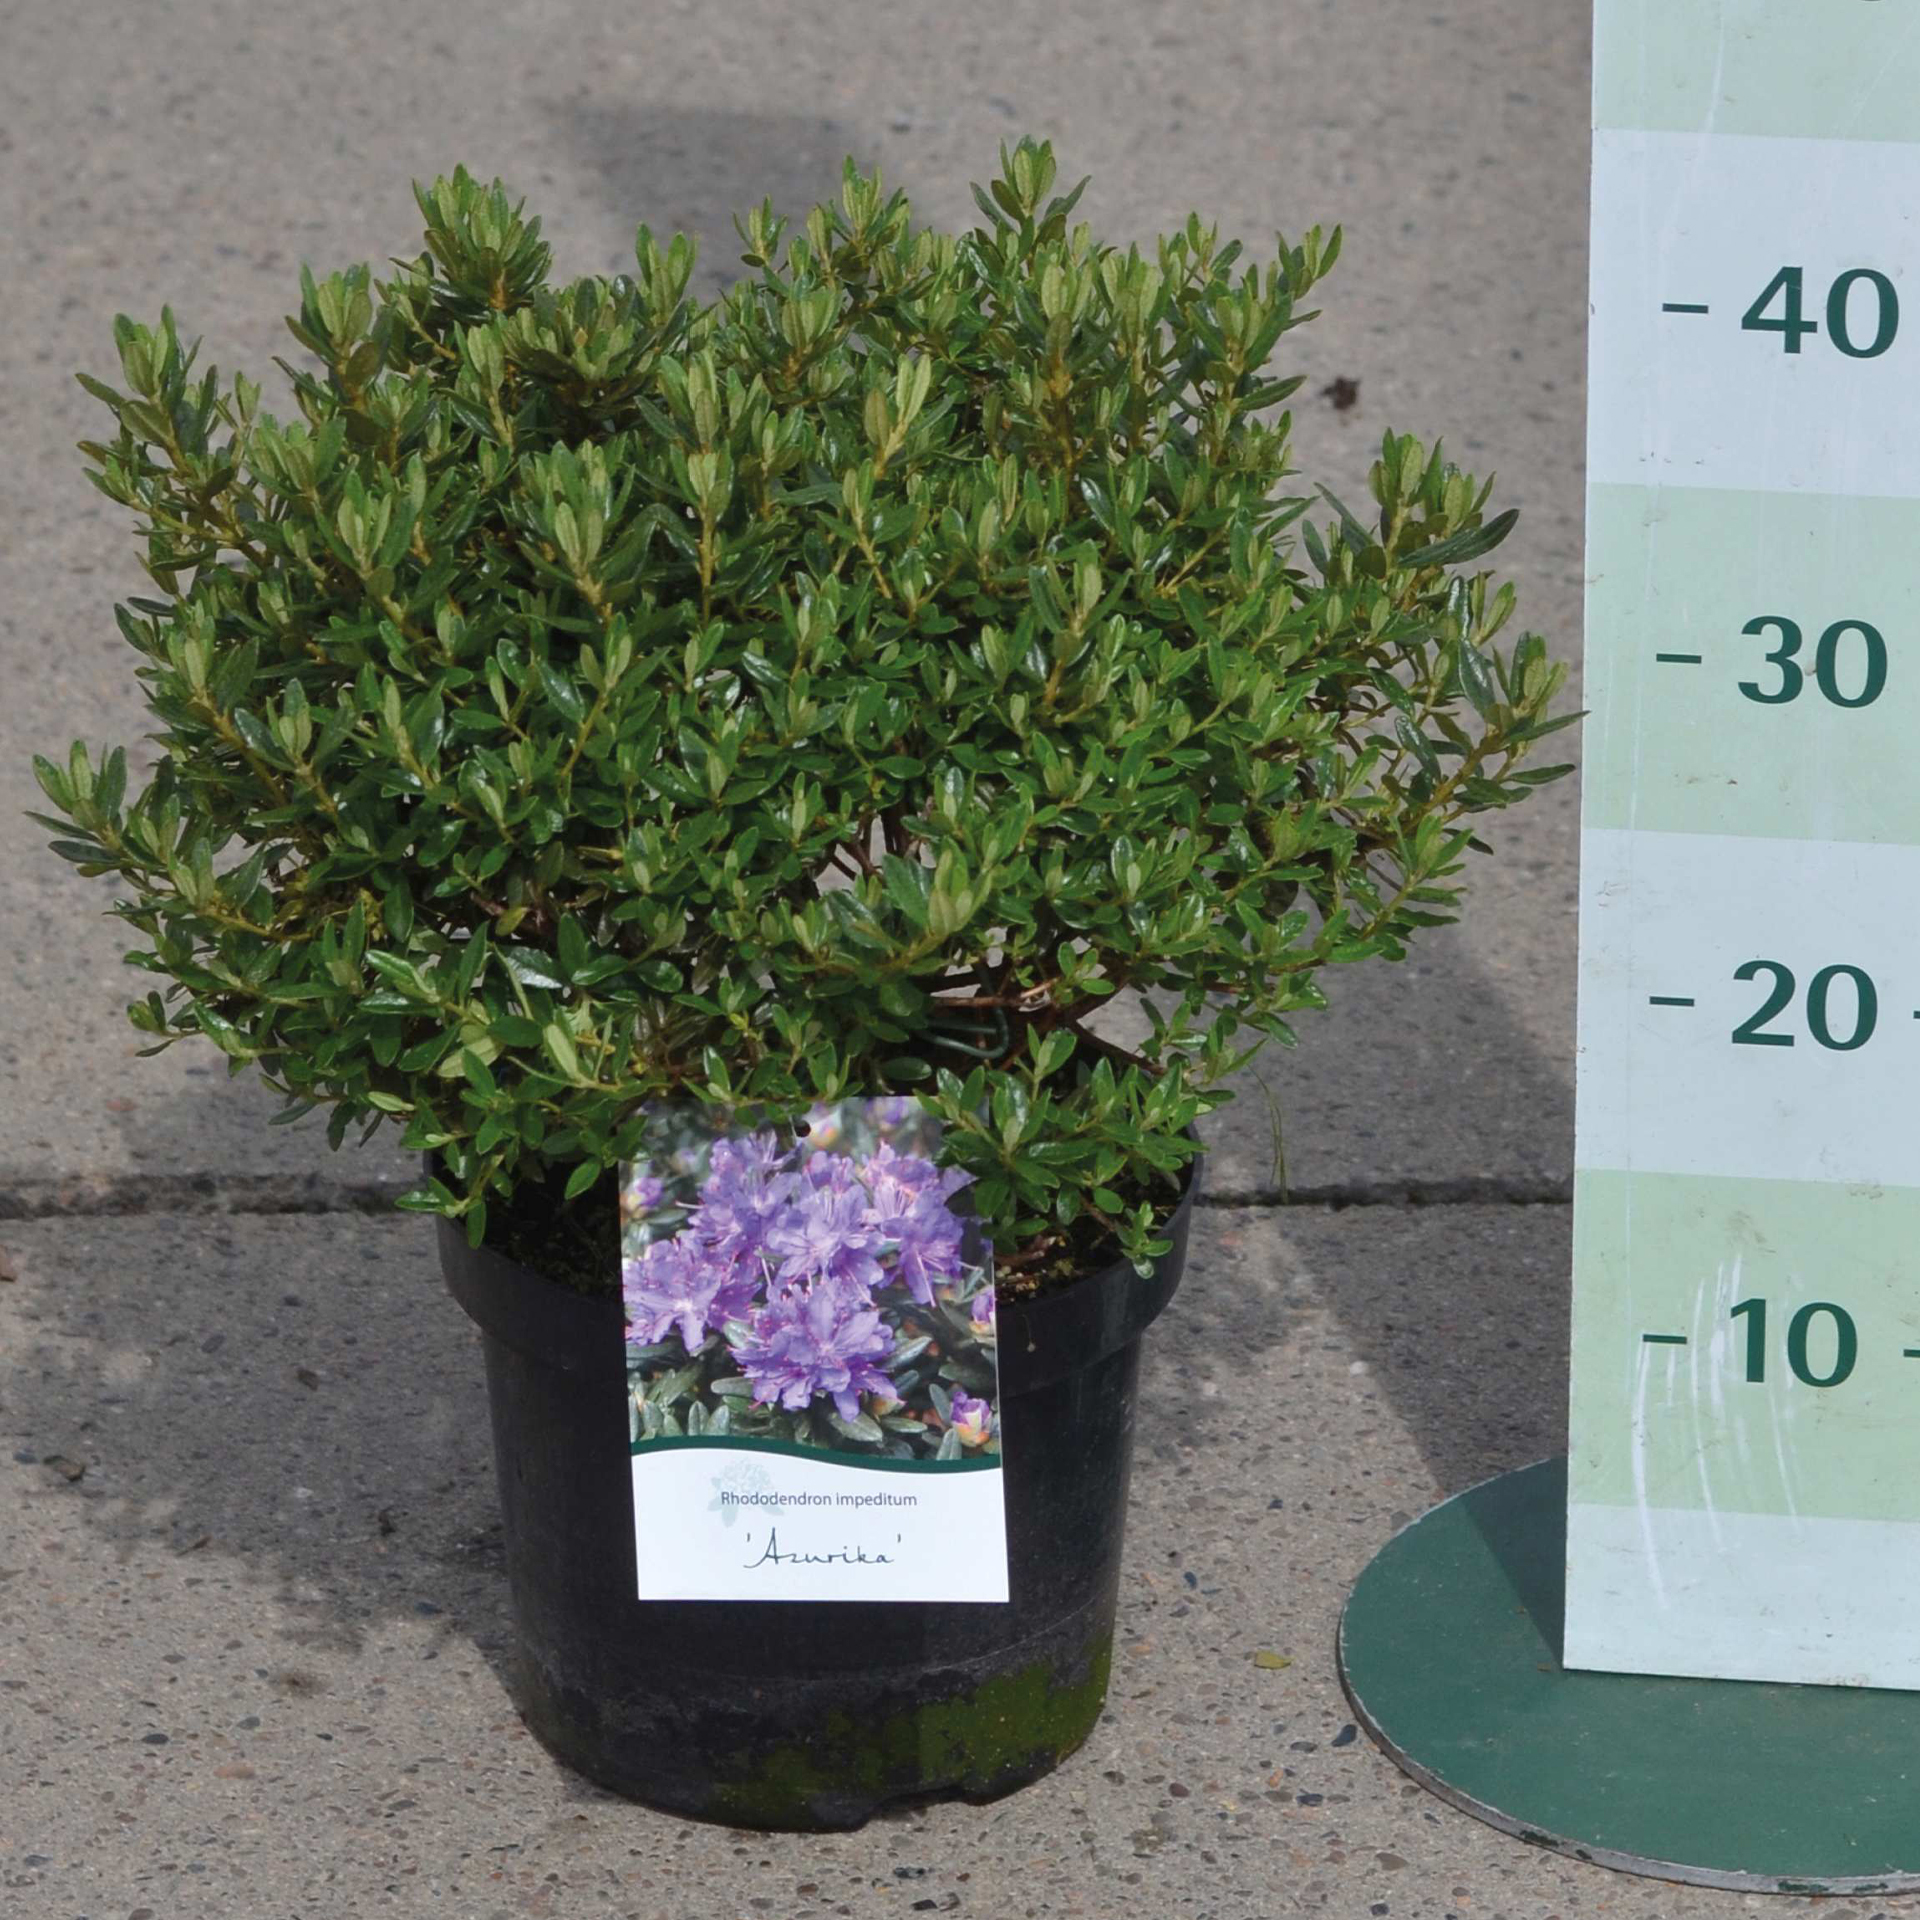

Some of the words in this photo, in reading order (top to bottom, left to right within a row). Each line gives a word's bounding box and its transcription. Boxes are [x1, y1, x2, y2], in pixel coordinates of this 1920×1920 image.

[1741, 266, 1900, 359] 40
[1737, 615, 1888, 709] 30
[1731, 959, 1878, 1051] 20
[1730, 1298, 1858, 1388] 10
[720, 1490, 832, 1506] Rhododendron
[836, 1490, 917, 1508] impeditum
